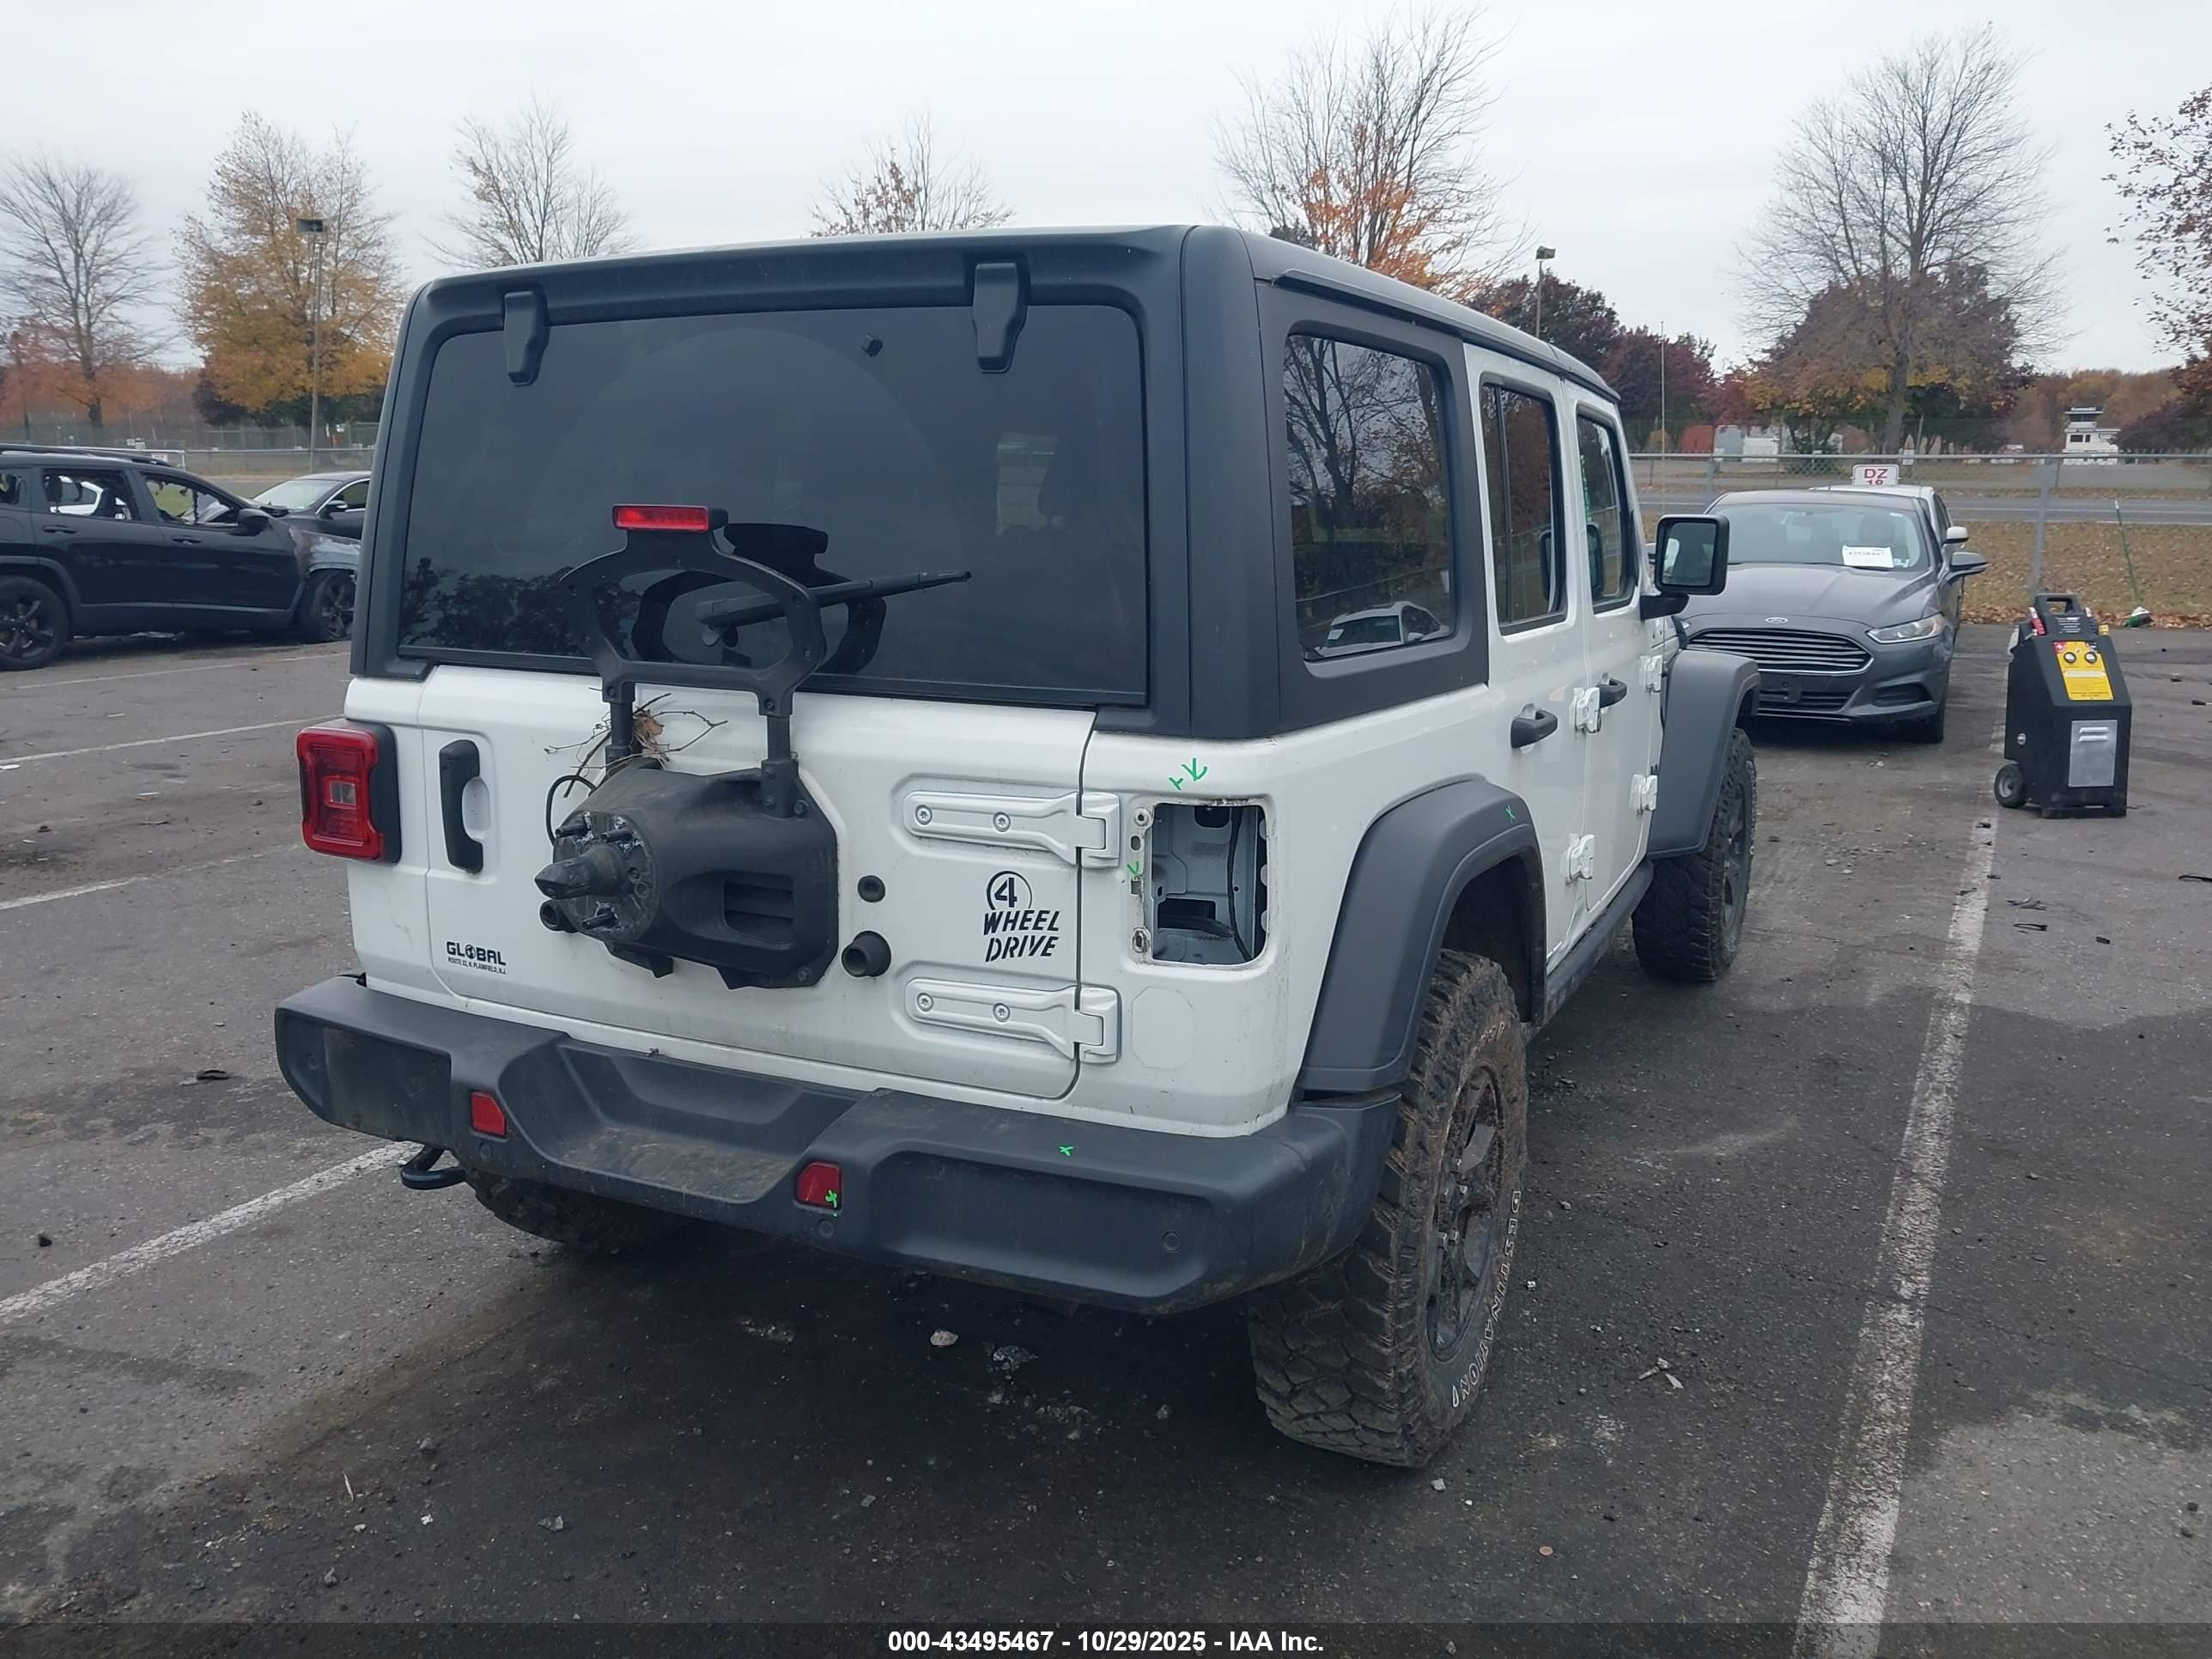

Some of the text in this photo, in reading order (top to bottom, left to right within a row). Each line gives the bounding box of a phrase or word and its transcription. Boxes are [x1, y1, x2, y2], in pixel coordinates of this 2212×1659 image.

[1864, 468, 1889, 479] DZ
[994, 877, 1018, 908] 4
[983, 910, 1060, 936] WHEEL
[446, 941, 507, 967] GLOBAL
[985, 935, 1060, 963] DRIVE
[1460, 1191, 1522, 1401] DESTINATION
